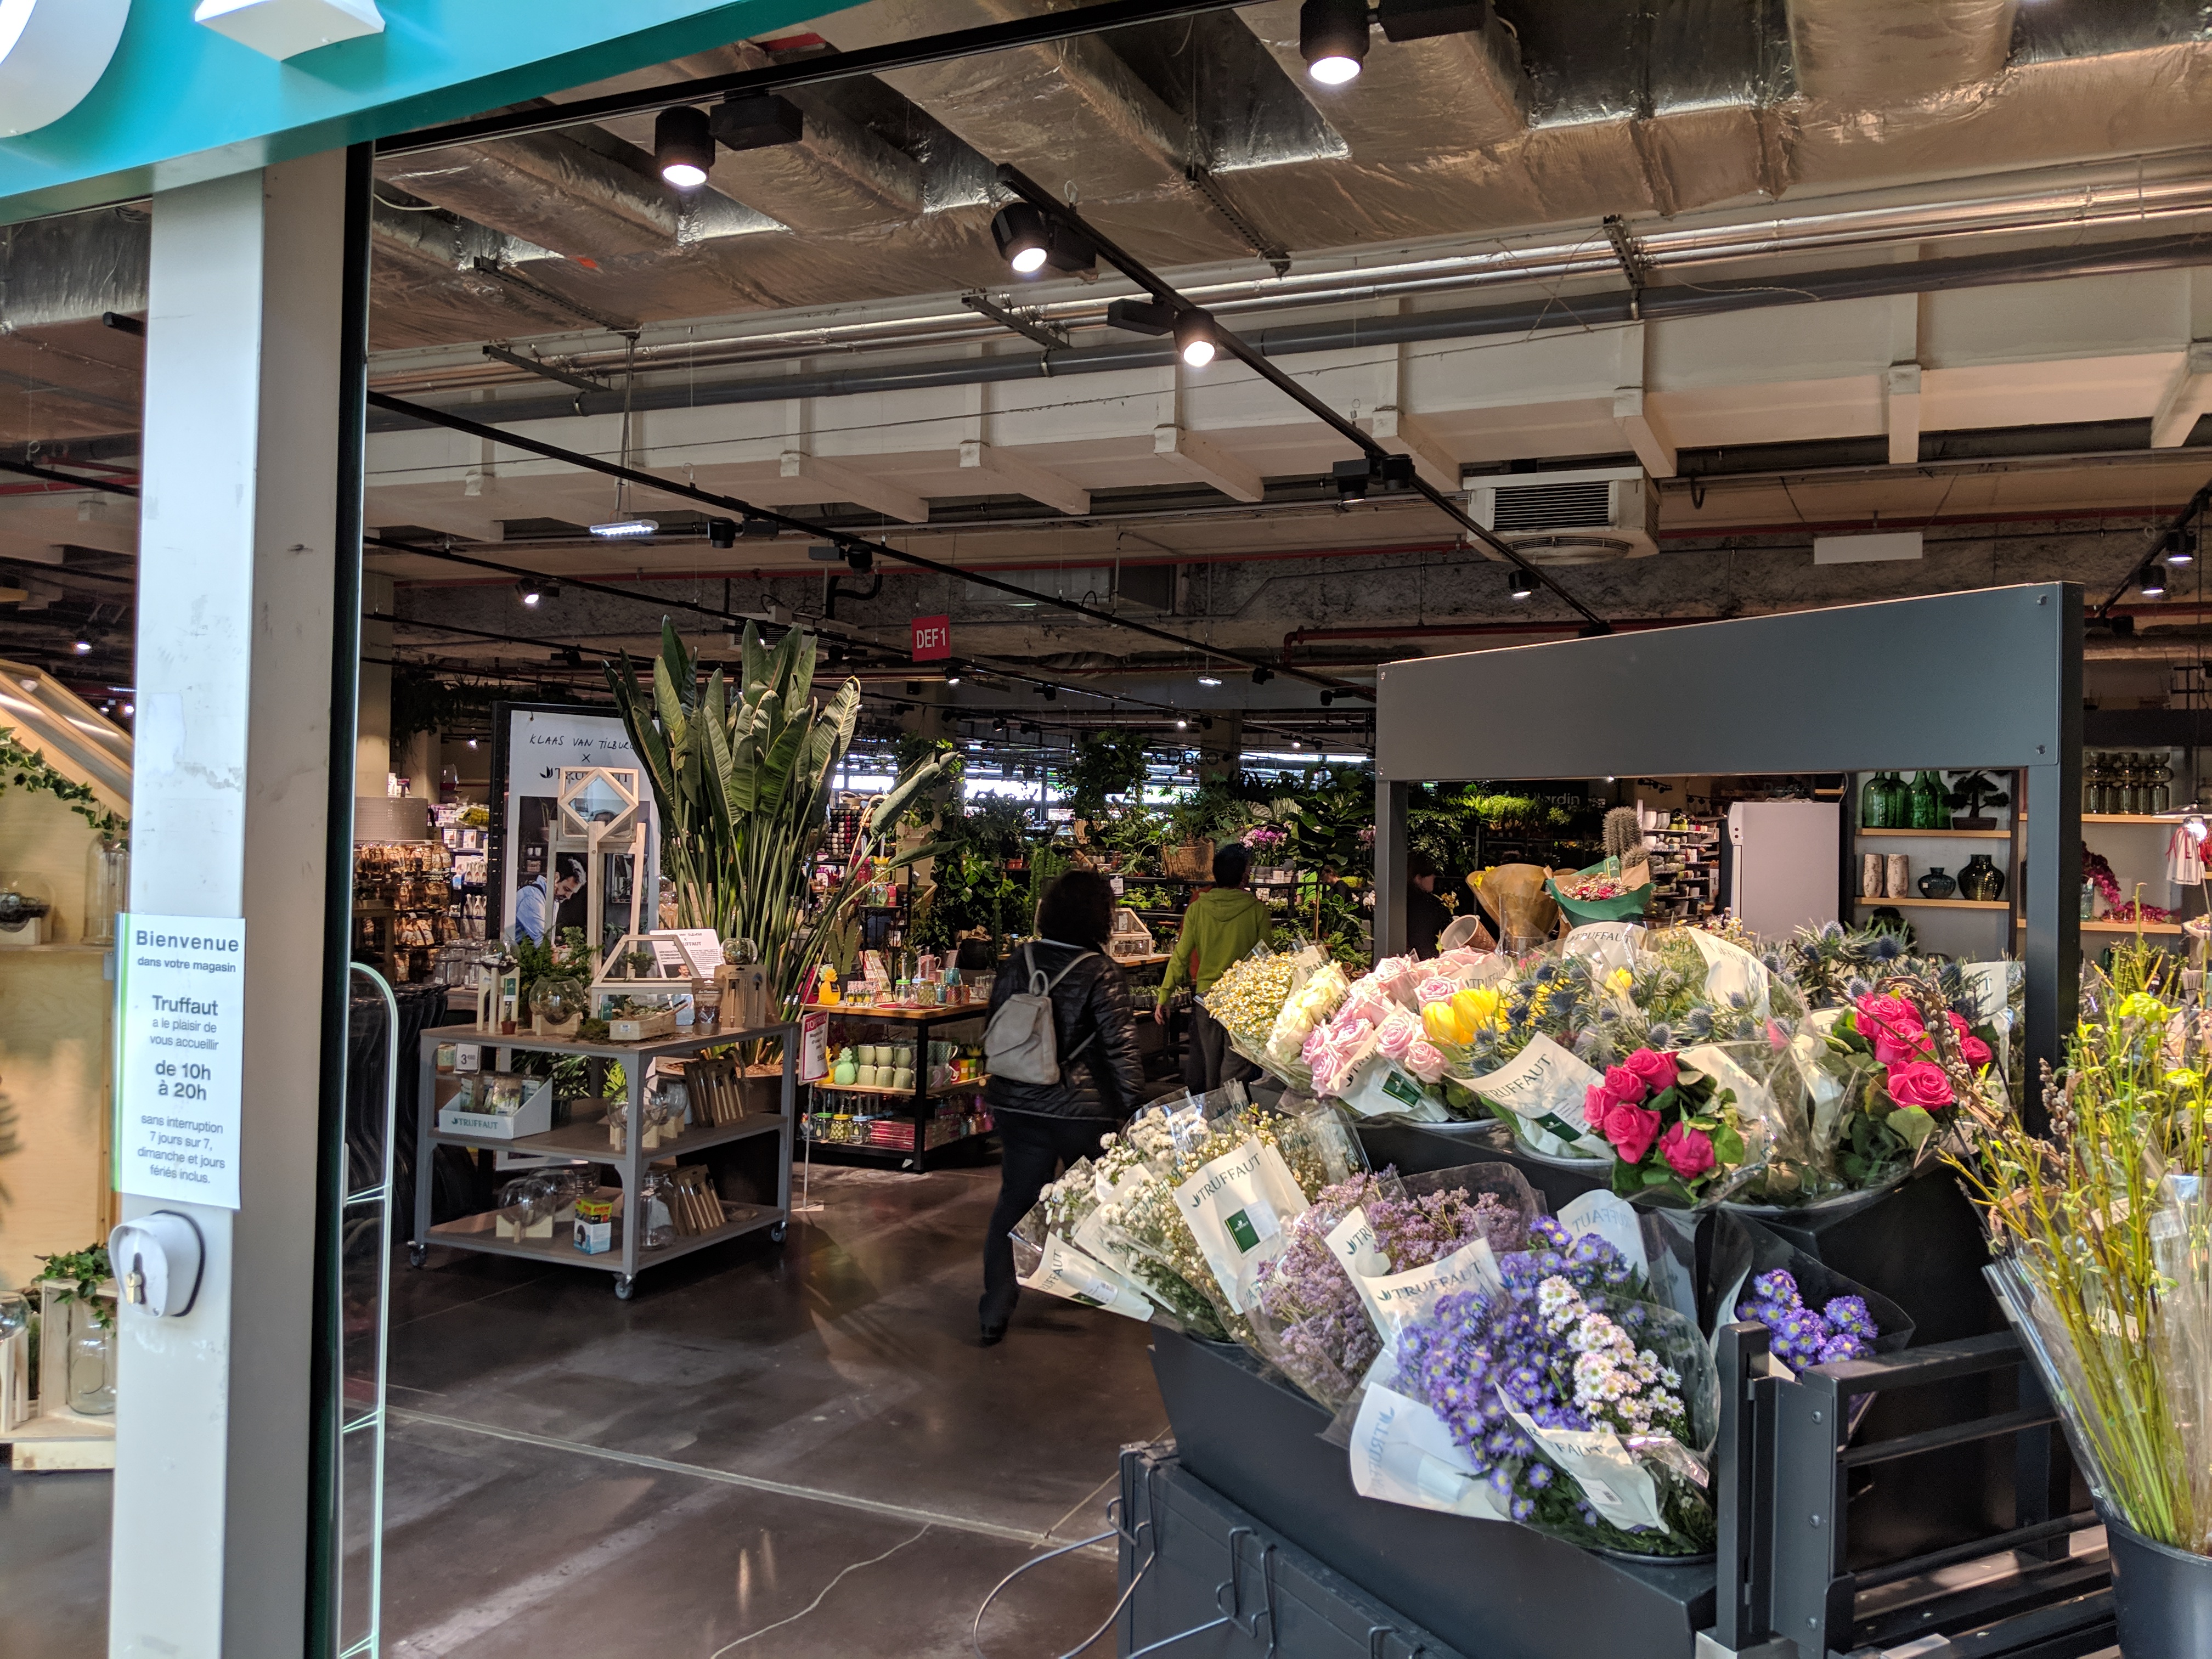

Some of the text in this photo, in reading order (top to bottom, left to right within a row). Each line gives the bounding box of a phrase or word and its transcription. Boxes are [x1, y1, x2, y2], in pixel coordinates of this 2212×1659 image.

[529, 734, 565, 746] KLAAS
[573, 738, 594, 747] VAN
[136, 930, 239, 952] Bienvenue
[137, 956, 236, 973] dans votre magasin
[152, 995, 218, 1016] Truffaut
[153, 1017, 217, 1035] a le plaisir de
[150, 1035, 219, 1051] vous accueillir
[155, 1060, 211, 1081] de 10h
[1484, 1053, 1551, 1099] TRUFFAUT
[159, 1080, 207, 1101] à 20h
[141, 1114, 223, 1134] sans interruption
[458, 1118, 498, 1130] TRUFFAUT
[150, 1131, 213, 1152] 7 jours sur 7,
[137, 1147, 225, 1169] dimanche et jours
[150, 1164, 211, 1184] fériés inclus.
[1198, 1153, 1261, 1200] TRUFFAUT
[1039, 1249, 1063, 1290] RUFFAUT
[1391, 1260, 1481, 1299] TRUFFAUT
